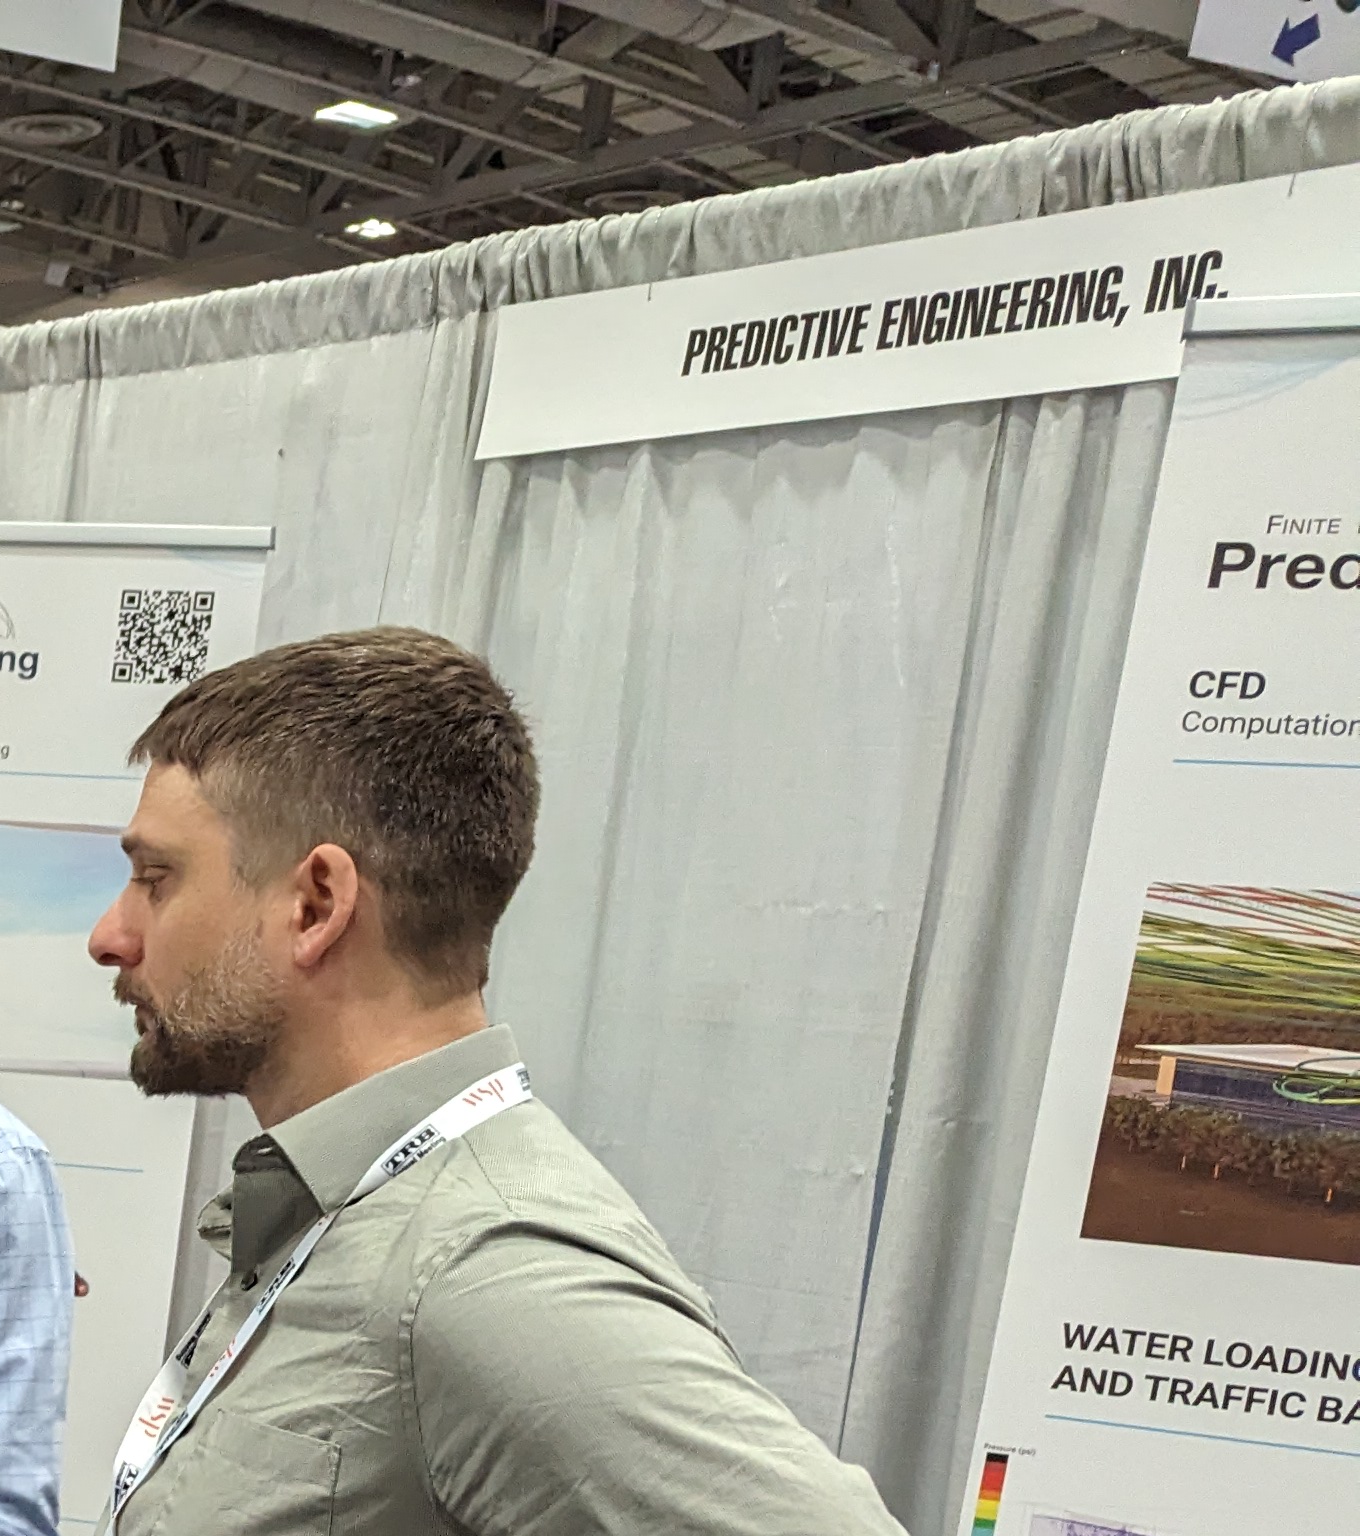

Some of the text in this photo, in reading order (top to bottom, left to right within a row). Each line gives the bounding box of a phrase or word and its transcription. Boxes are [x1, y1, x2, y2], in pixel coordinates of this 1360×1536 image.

[681, 250, 1229, 377] PREDICTIVE ENGINEERING, INC.
[1266, 514, 1342, 535] FINITE
[1189, 670, 1266, 700] CFD
[385, 1128, 436, 1170] TRB
[1063, 1322, 1194, 1363] WATER
[1050, 1365, 1134, 1397] AND
[1145, 1374, 1307, 1418] TRAFFIC
